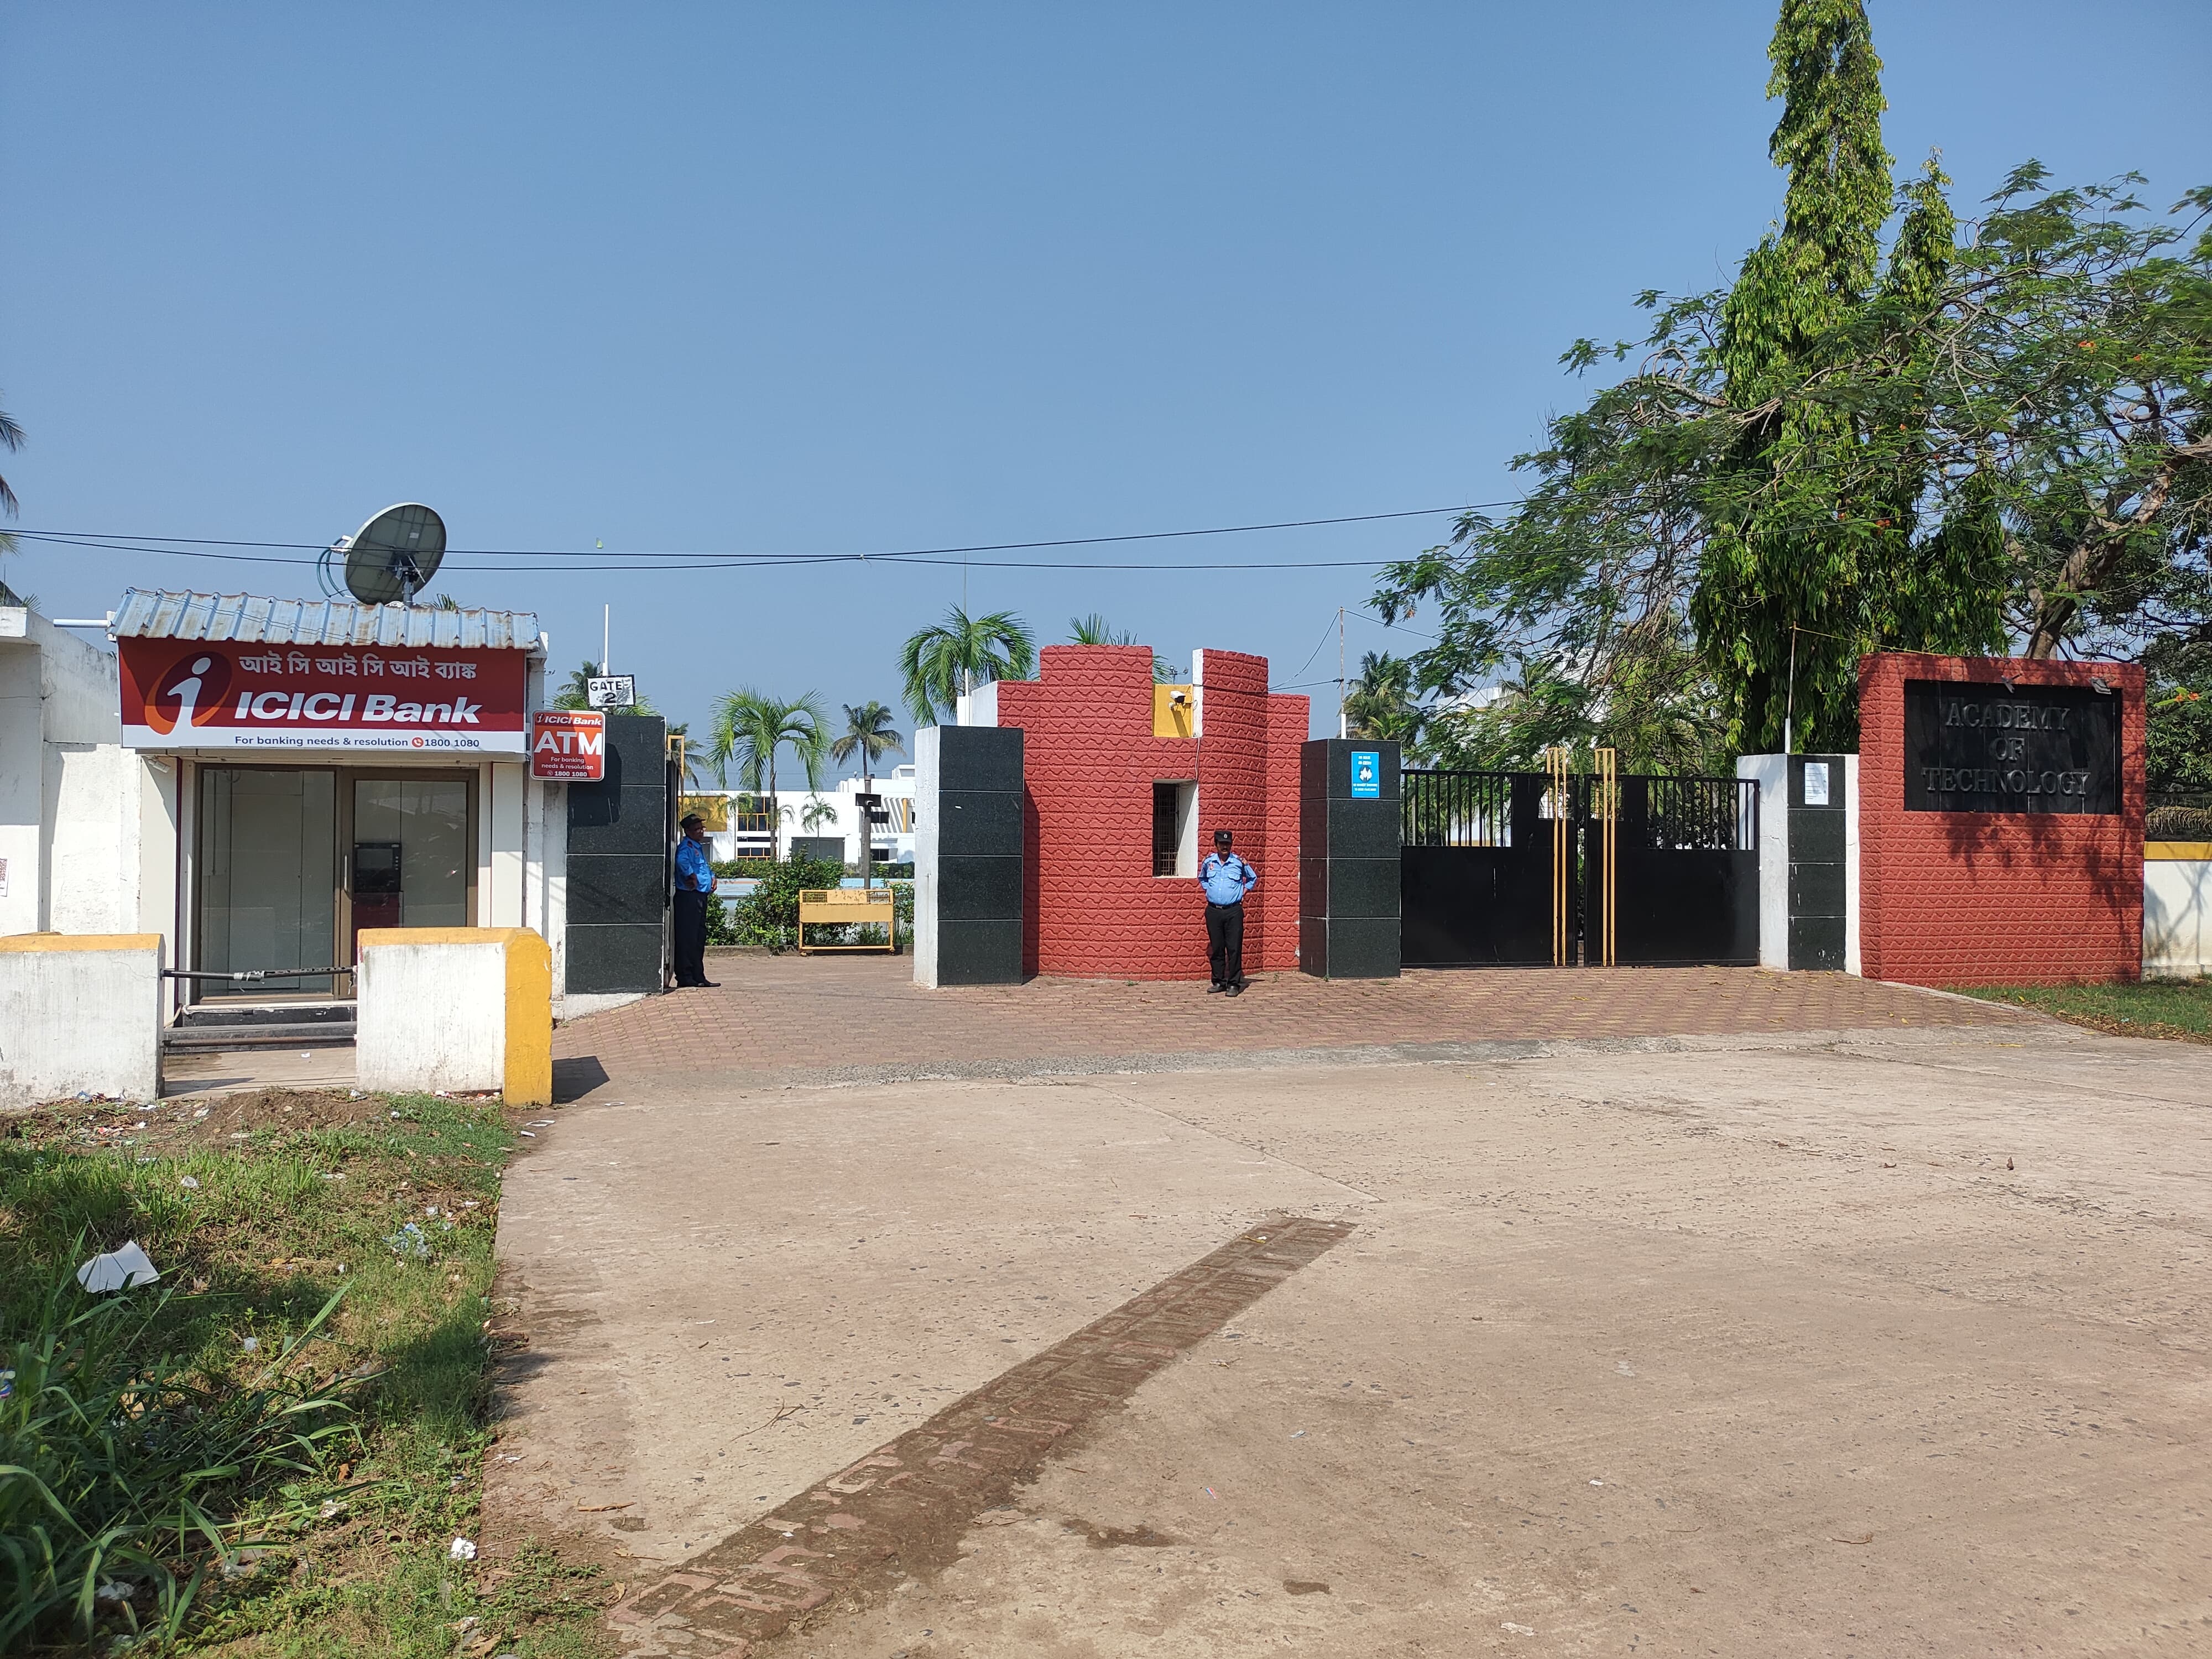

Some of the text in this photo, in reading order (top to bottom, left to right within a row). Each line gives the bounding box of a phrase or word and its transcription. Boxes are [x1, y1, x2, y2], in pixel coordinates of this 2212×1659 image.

[238, 650, 477, 679] আই সি আই সি আই ব্যাঙ্ক
[589, 681, 623, 691] GATE
[604, 692, 617, 703] 2
[234, 691, 483, 723] ICICI Bank
[1945, 702, 2070, 731] ACADEMY
[545, 716, 572, 724] ICICI
[573, 717, 602, 726] Bank
[235, 736, 254, 744] For
[257, 736, 303, 747] banking
[354, 738, 408, 746] resolution
[534, 731, 602, 755] ATM
[1993, 737, 2025, 761] OF
[1922, 767, 2091, 796] TECHNOLOGY
